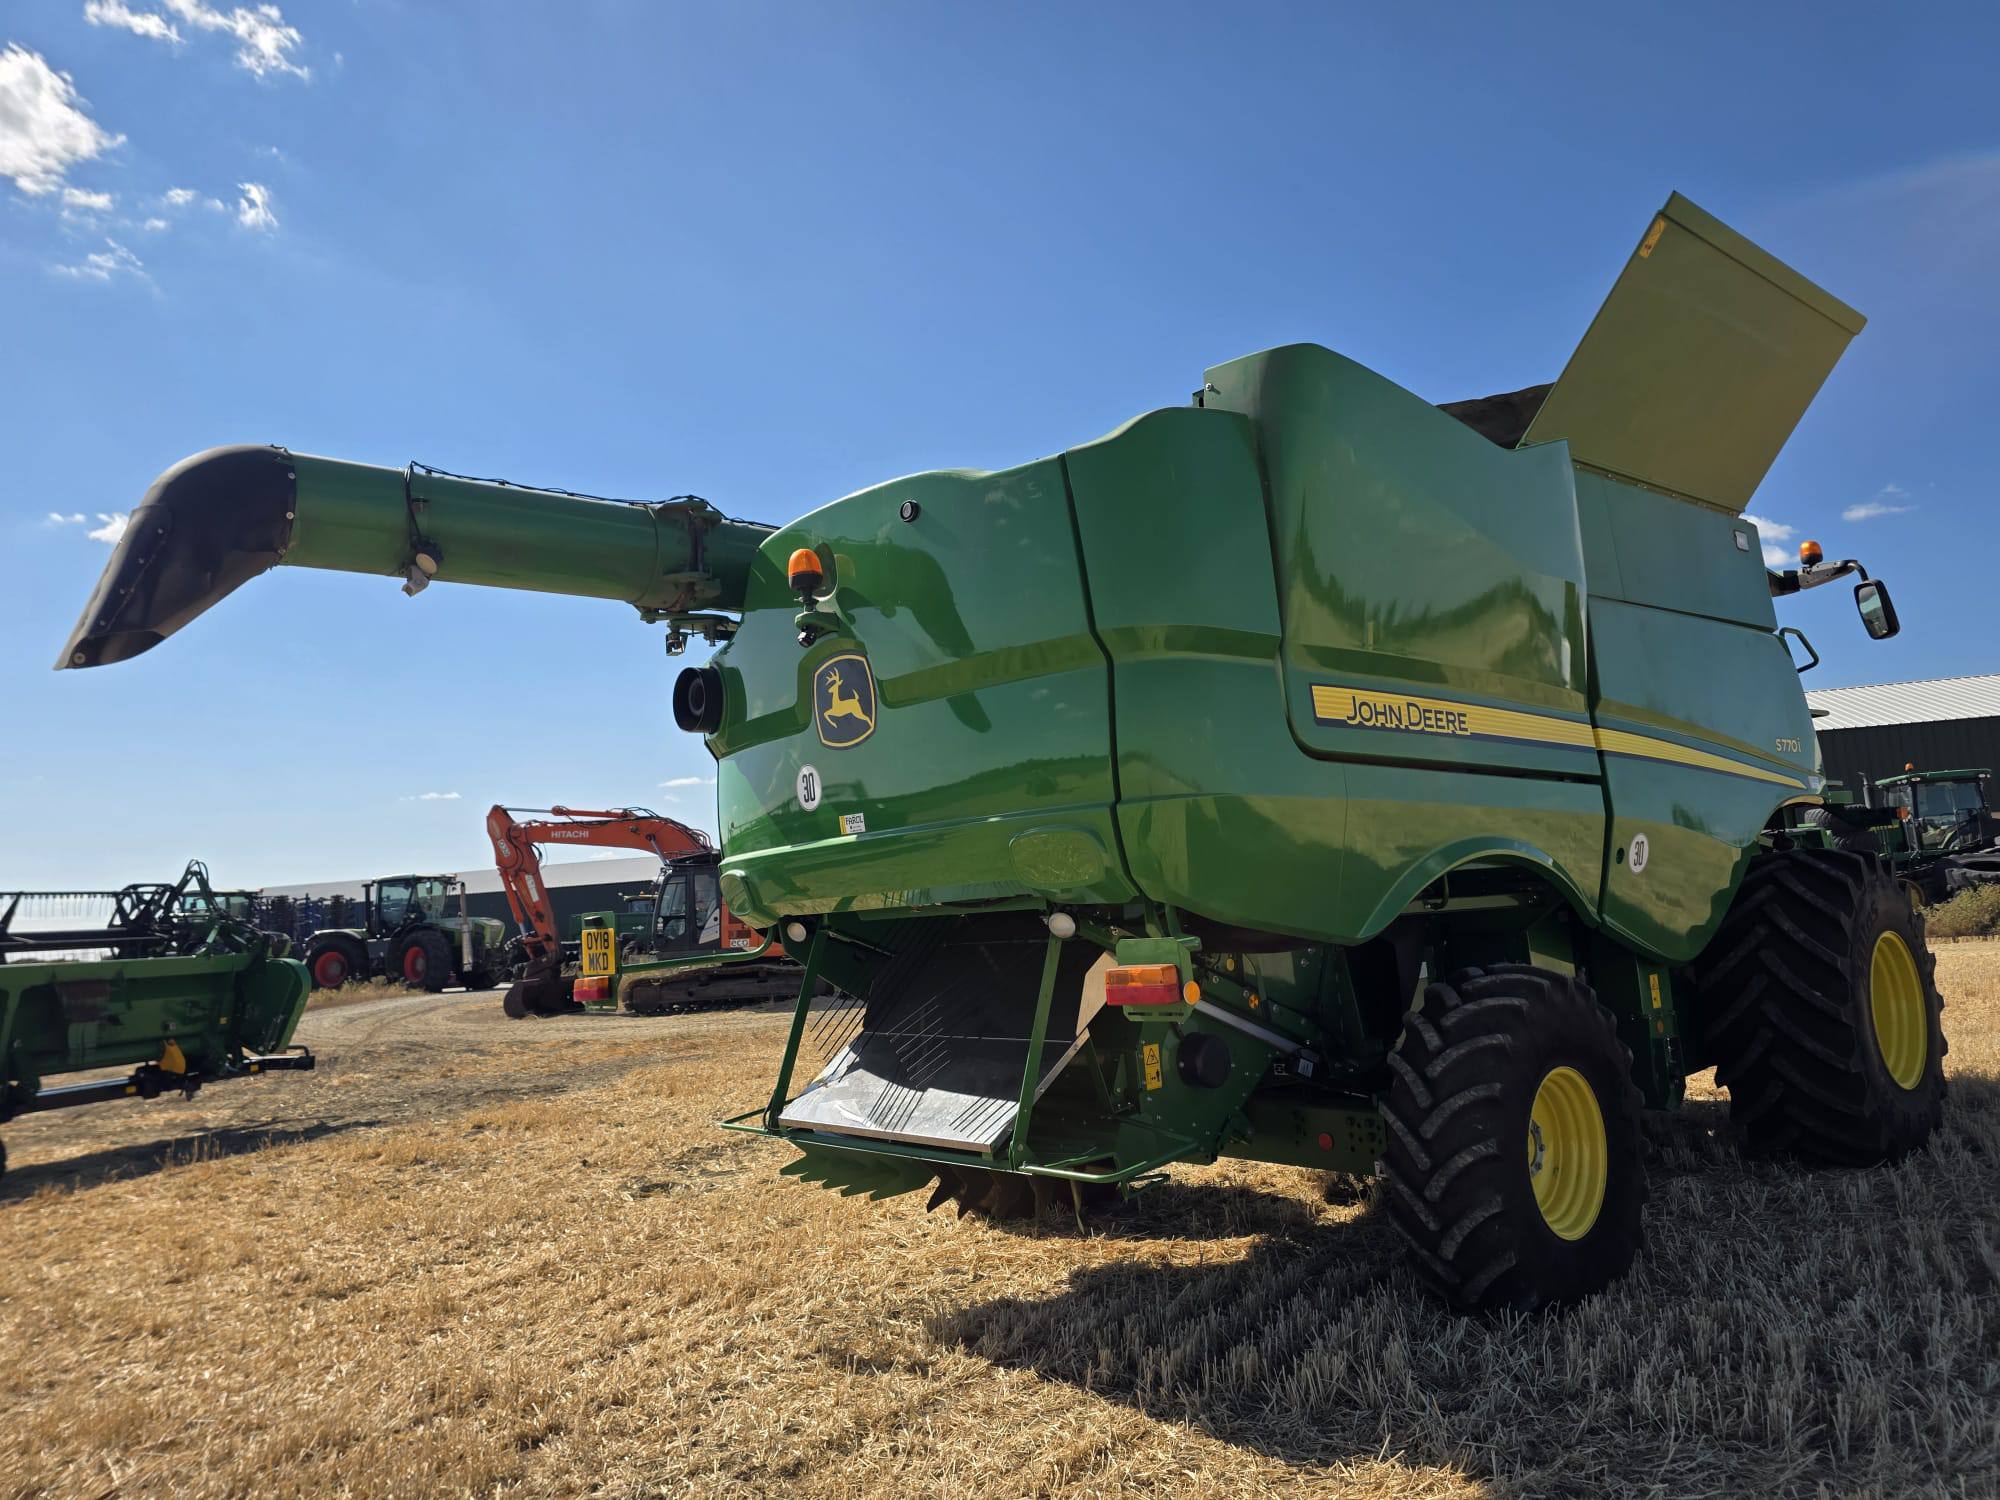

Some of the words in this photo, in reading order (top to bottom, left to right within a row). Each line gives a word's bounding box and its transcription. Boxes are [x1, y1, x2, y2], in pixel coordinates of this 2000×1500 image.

[1346, 695, 1403, 727] JOHN
[1407, 702, 1469, 733] DEERE
[1775, 737, 1802, 753] S770i
[802, 772, 816, 803] 30
[551, 830, 589, 839] HITACHI
[1633, 840, 1645, 867] 30
[586, 931, 609, 950] OY18
[588, 952, 609, 971] MKD
